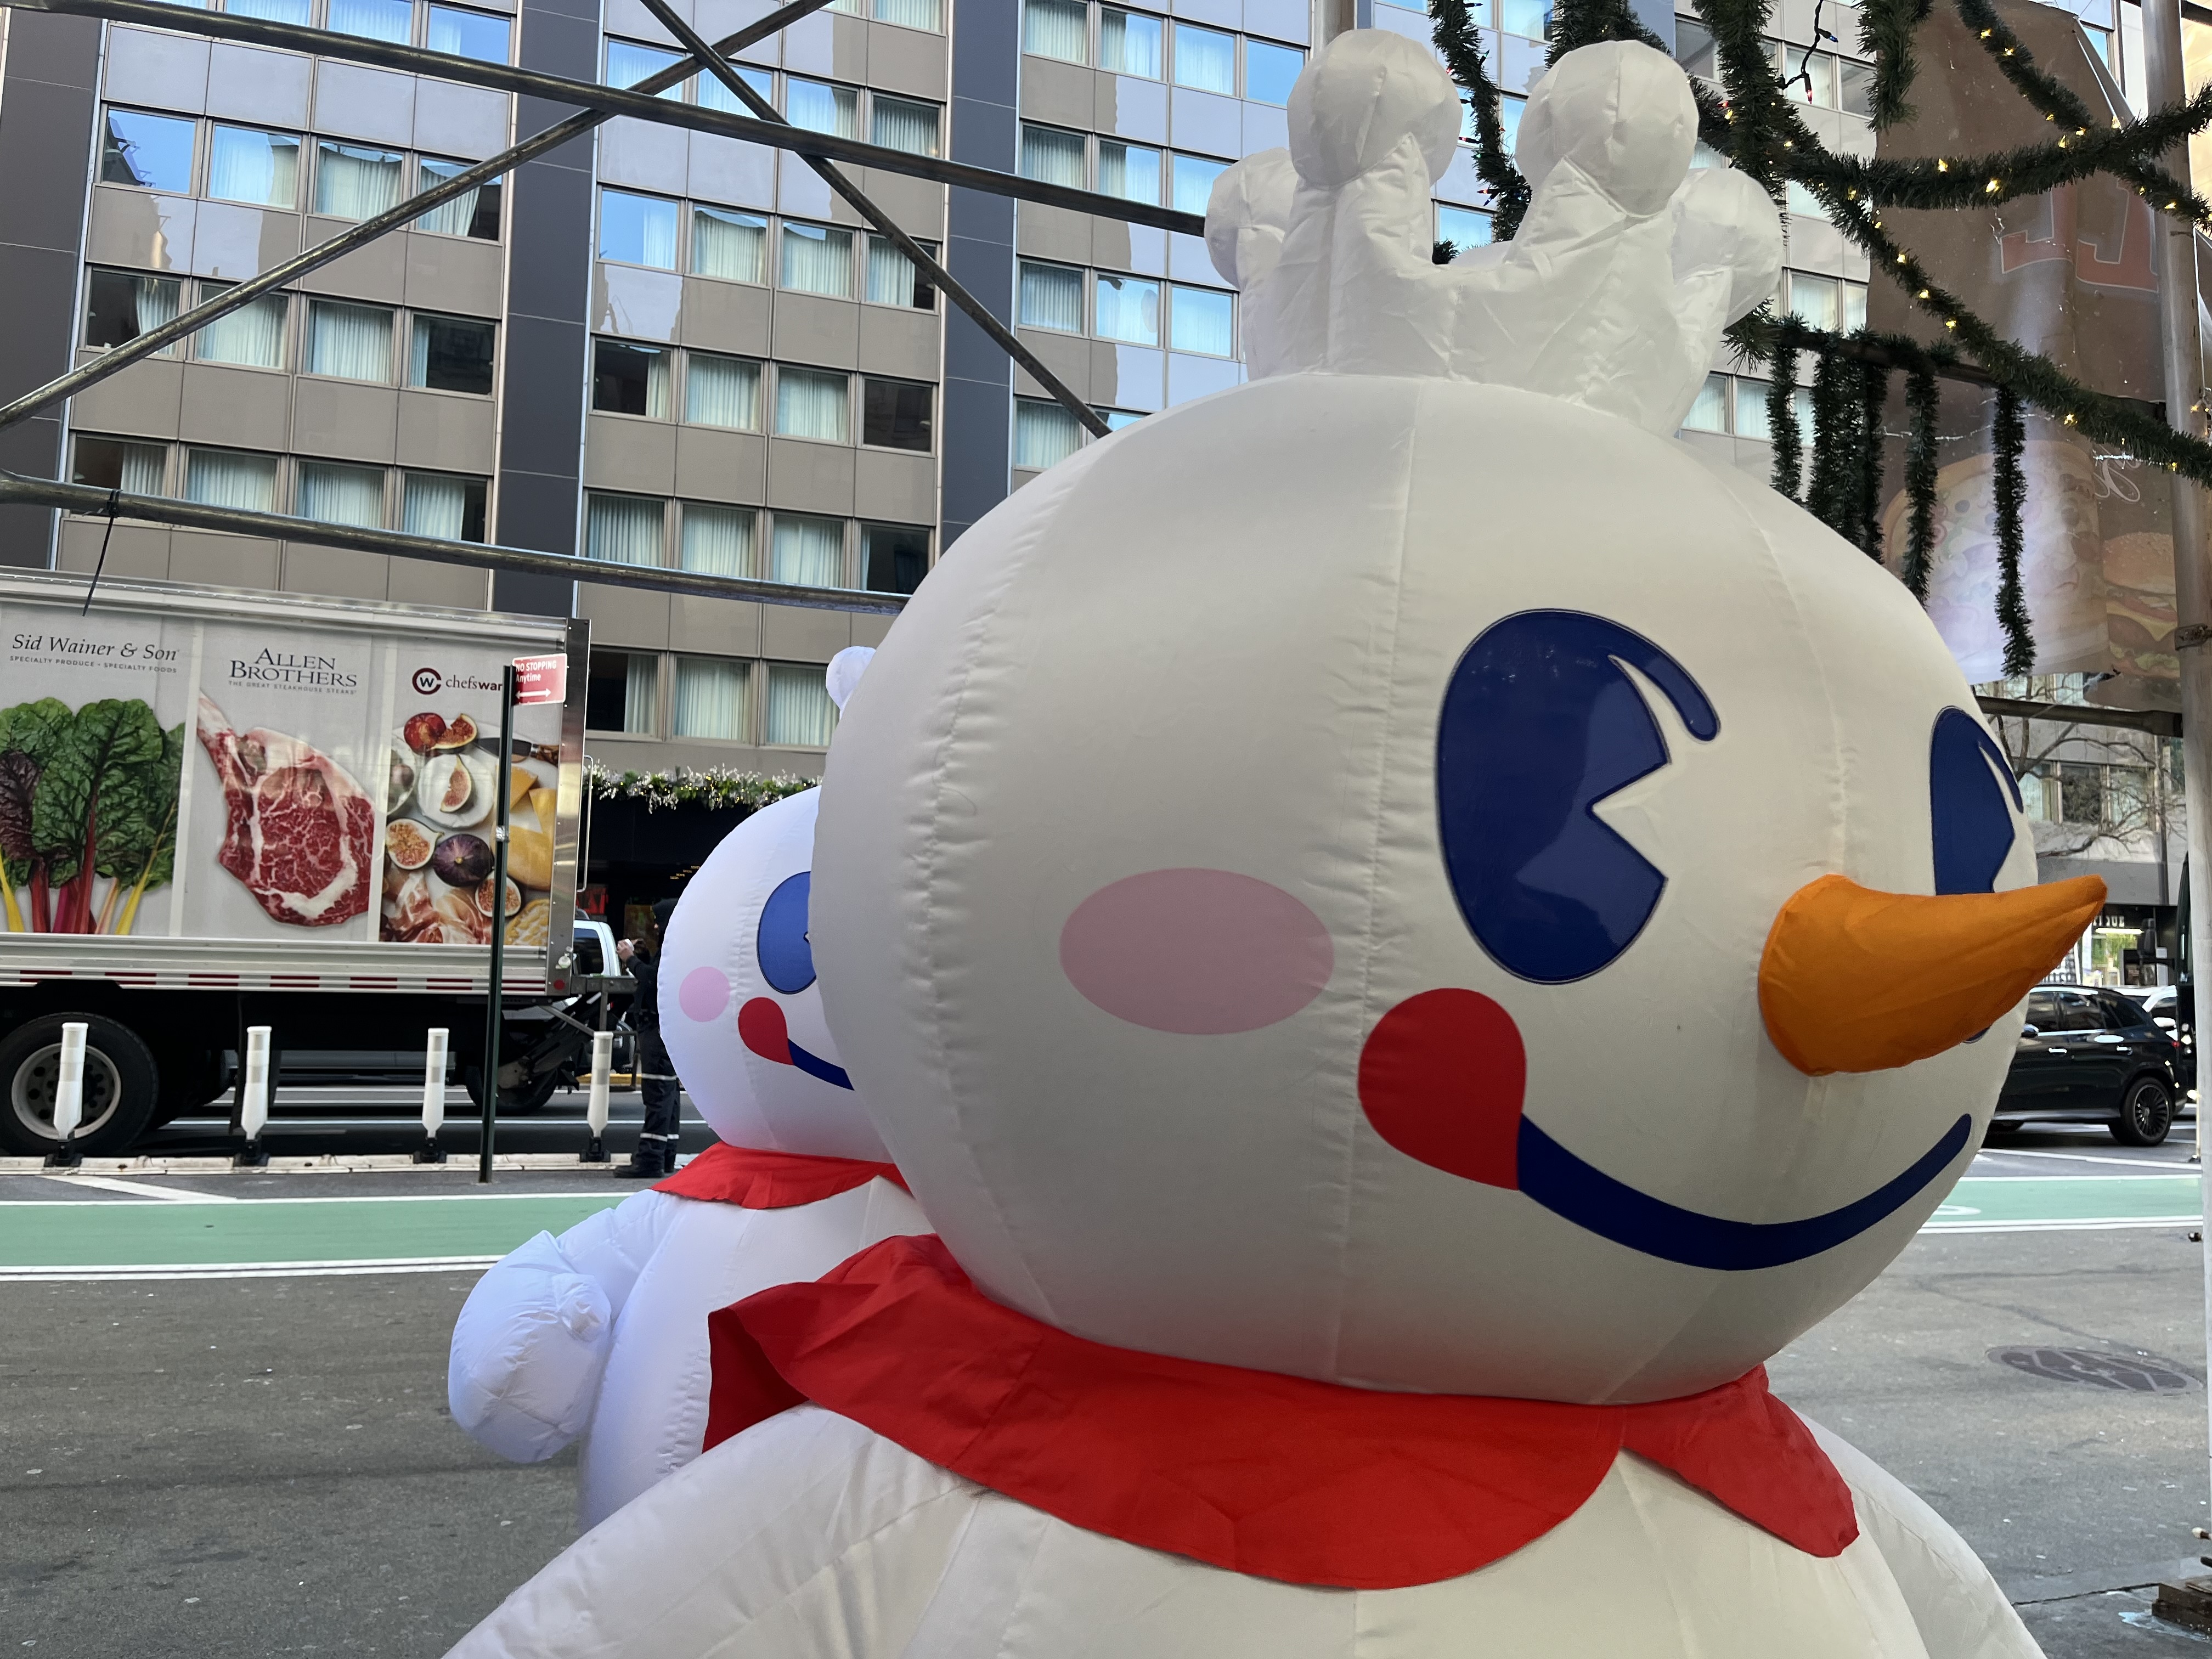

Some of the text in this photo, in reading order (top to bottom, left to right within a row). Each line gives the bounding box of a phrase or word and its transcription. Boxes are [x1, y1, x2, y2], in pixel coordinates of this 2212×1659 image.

[12, 634, 177, 661] Sid Wainer & Son
[10, 656, 53, 664] SPECIALTY
[55, 659, 95, 667] PRODUCE
[104, 662, 146, 671] SPECIALTY
[255, 647, 336, 670] ALLEN
[516, 660, 557, 673] NO STOPPING
[229, 660, 357, 687] BROTHERS
[516, 673, 541, 684] Anytime
